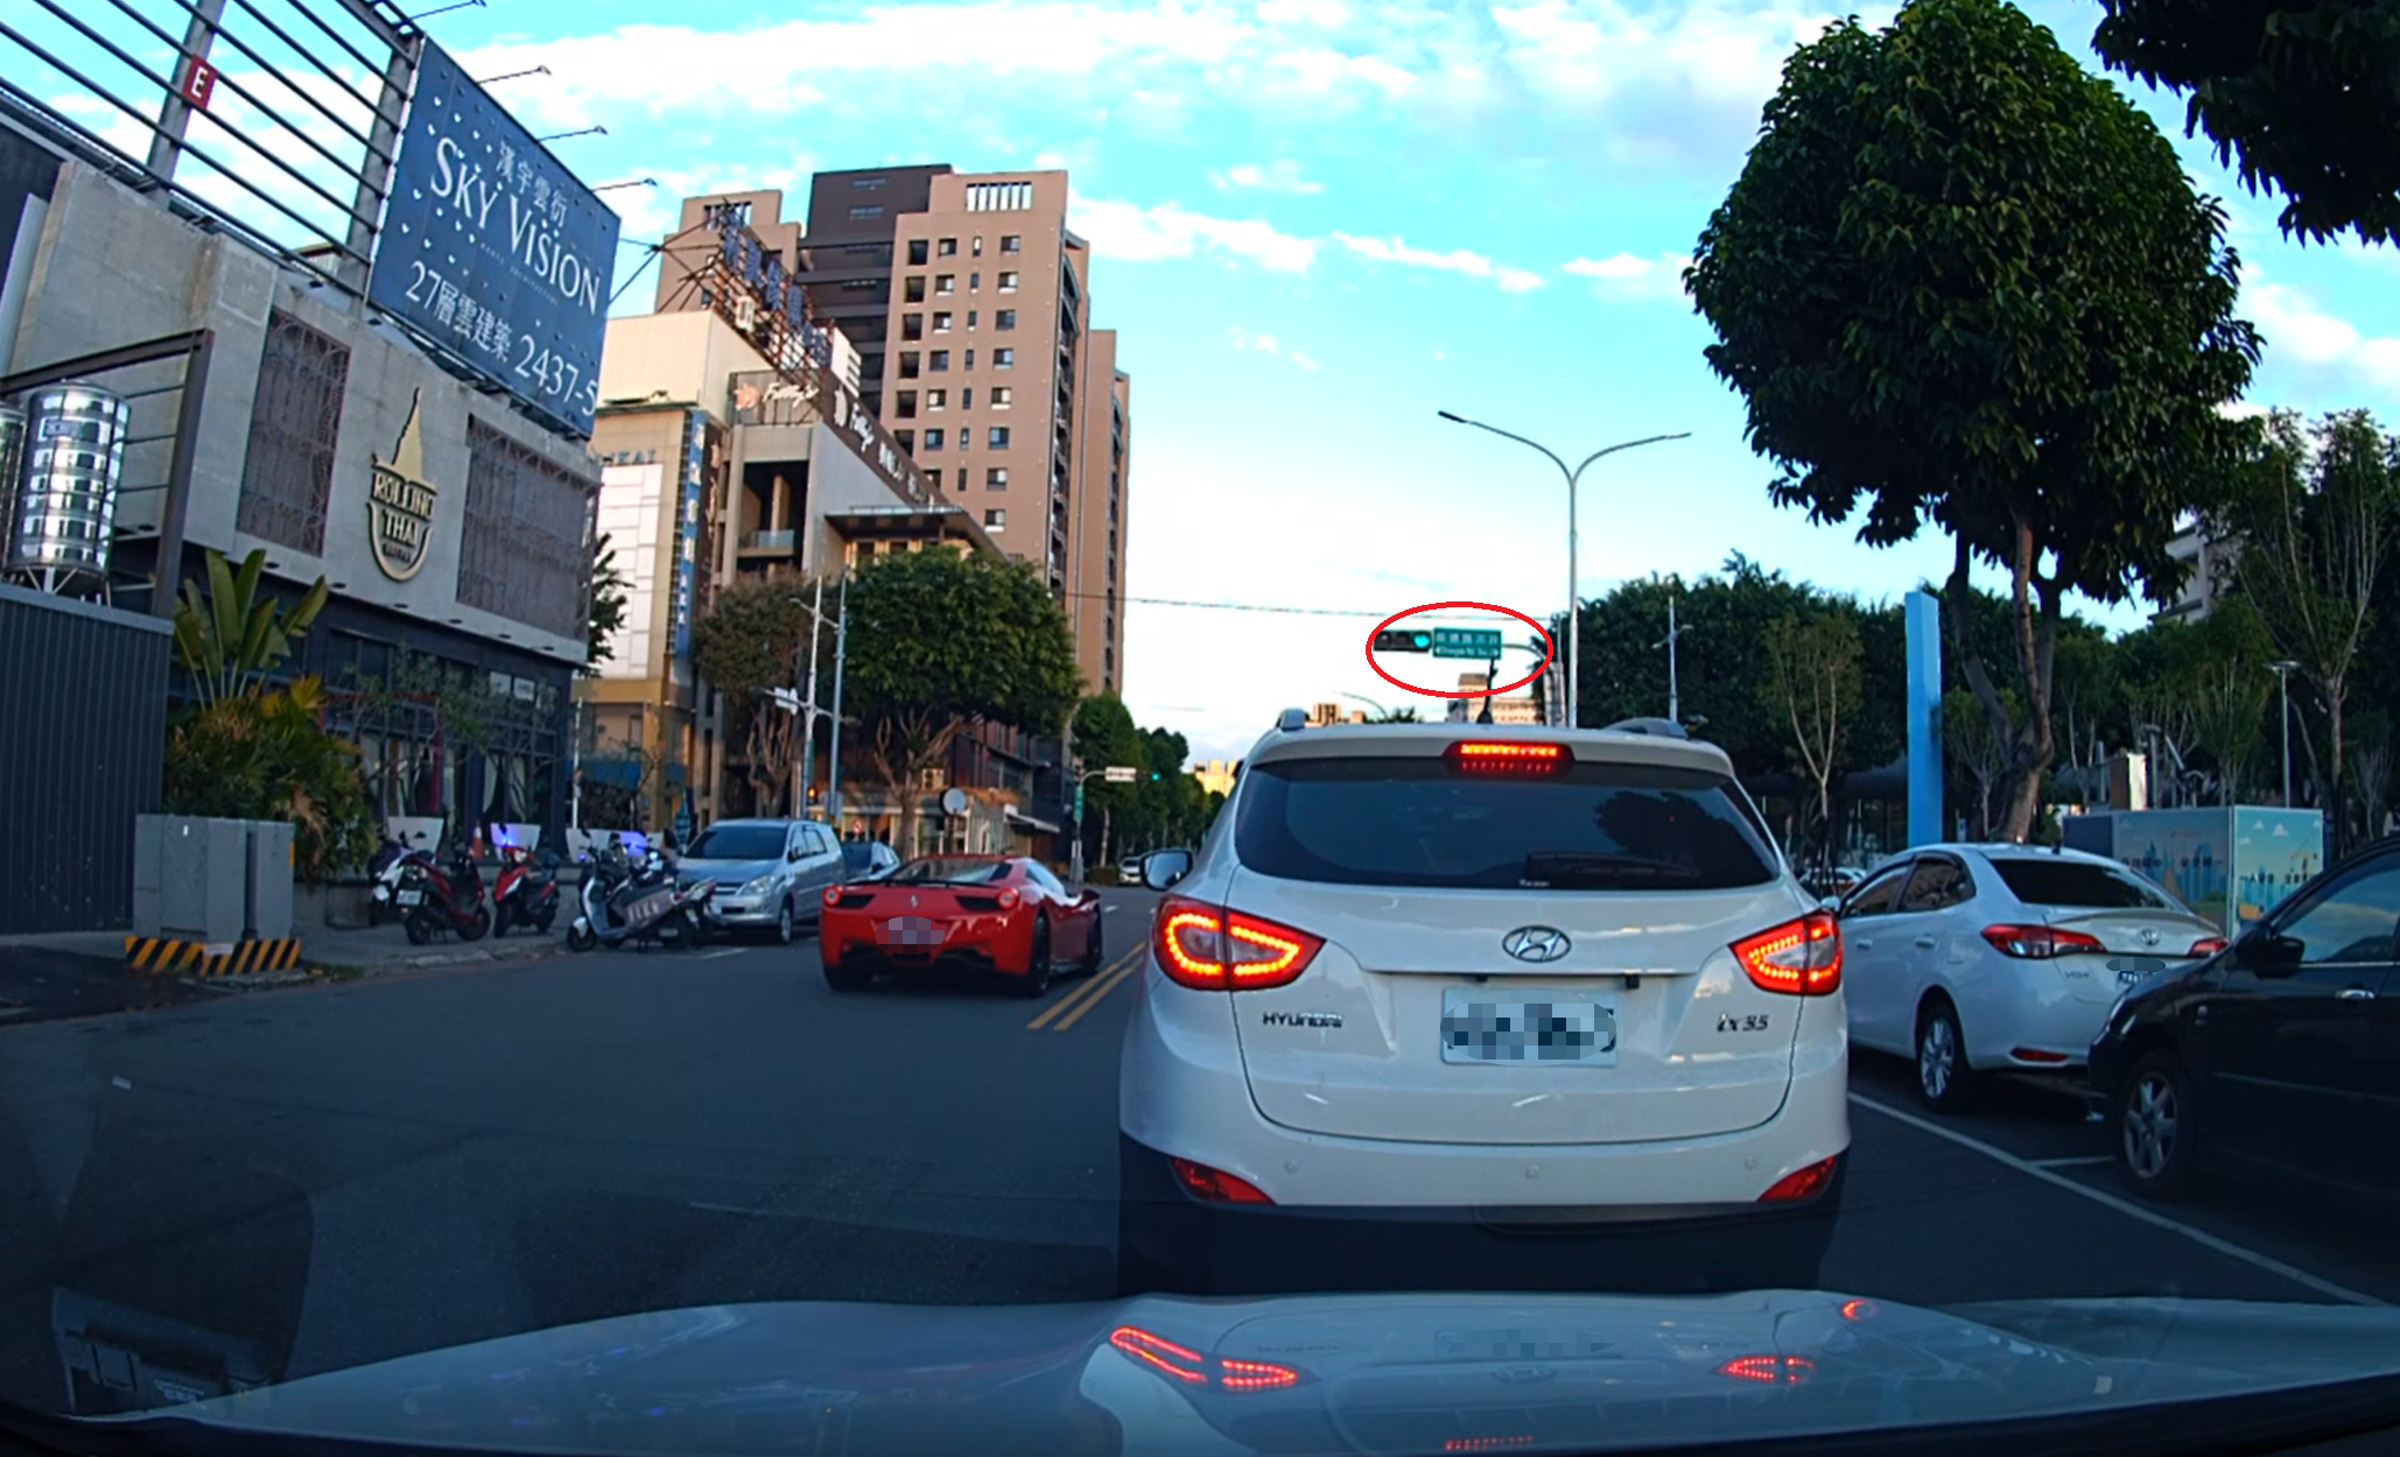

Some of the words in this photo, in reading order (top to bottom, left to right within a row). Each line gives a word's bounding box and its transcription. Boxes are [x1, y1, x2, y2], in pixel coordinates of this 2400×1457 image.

[191, 66, 208, 99] E
[431, 137, 498, 229] SKY
[510, 195, 600, 315] VISION
[384, 509, 419, 544] THAI
[1262, 1012, 1343, 1028] HYUNDAI
